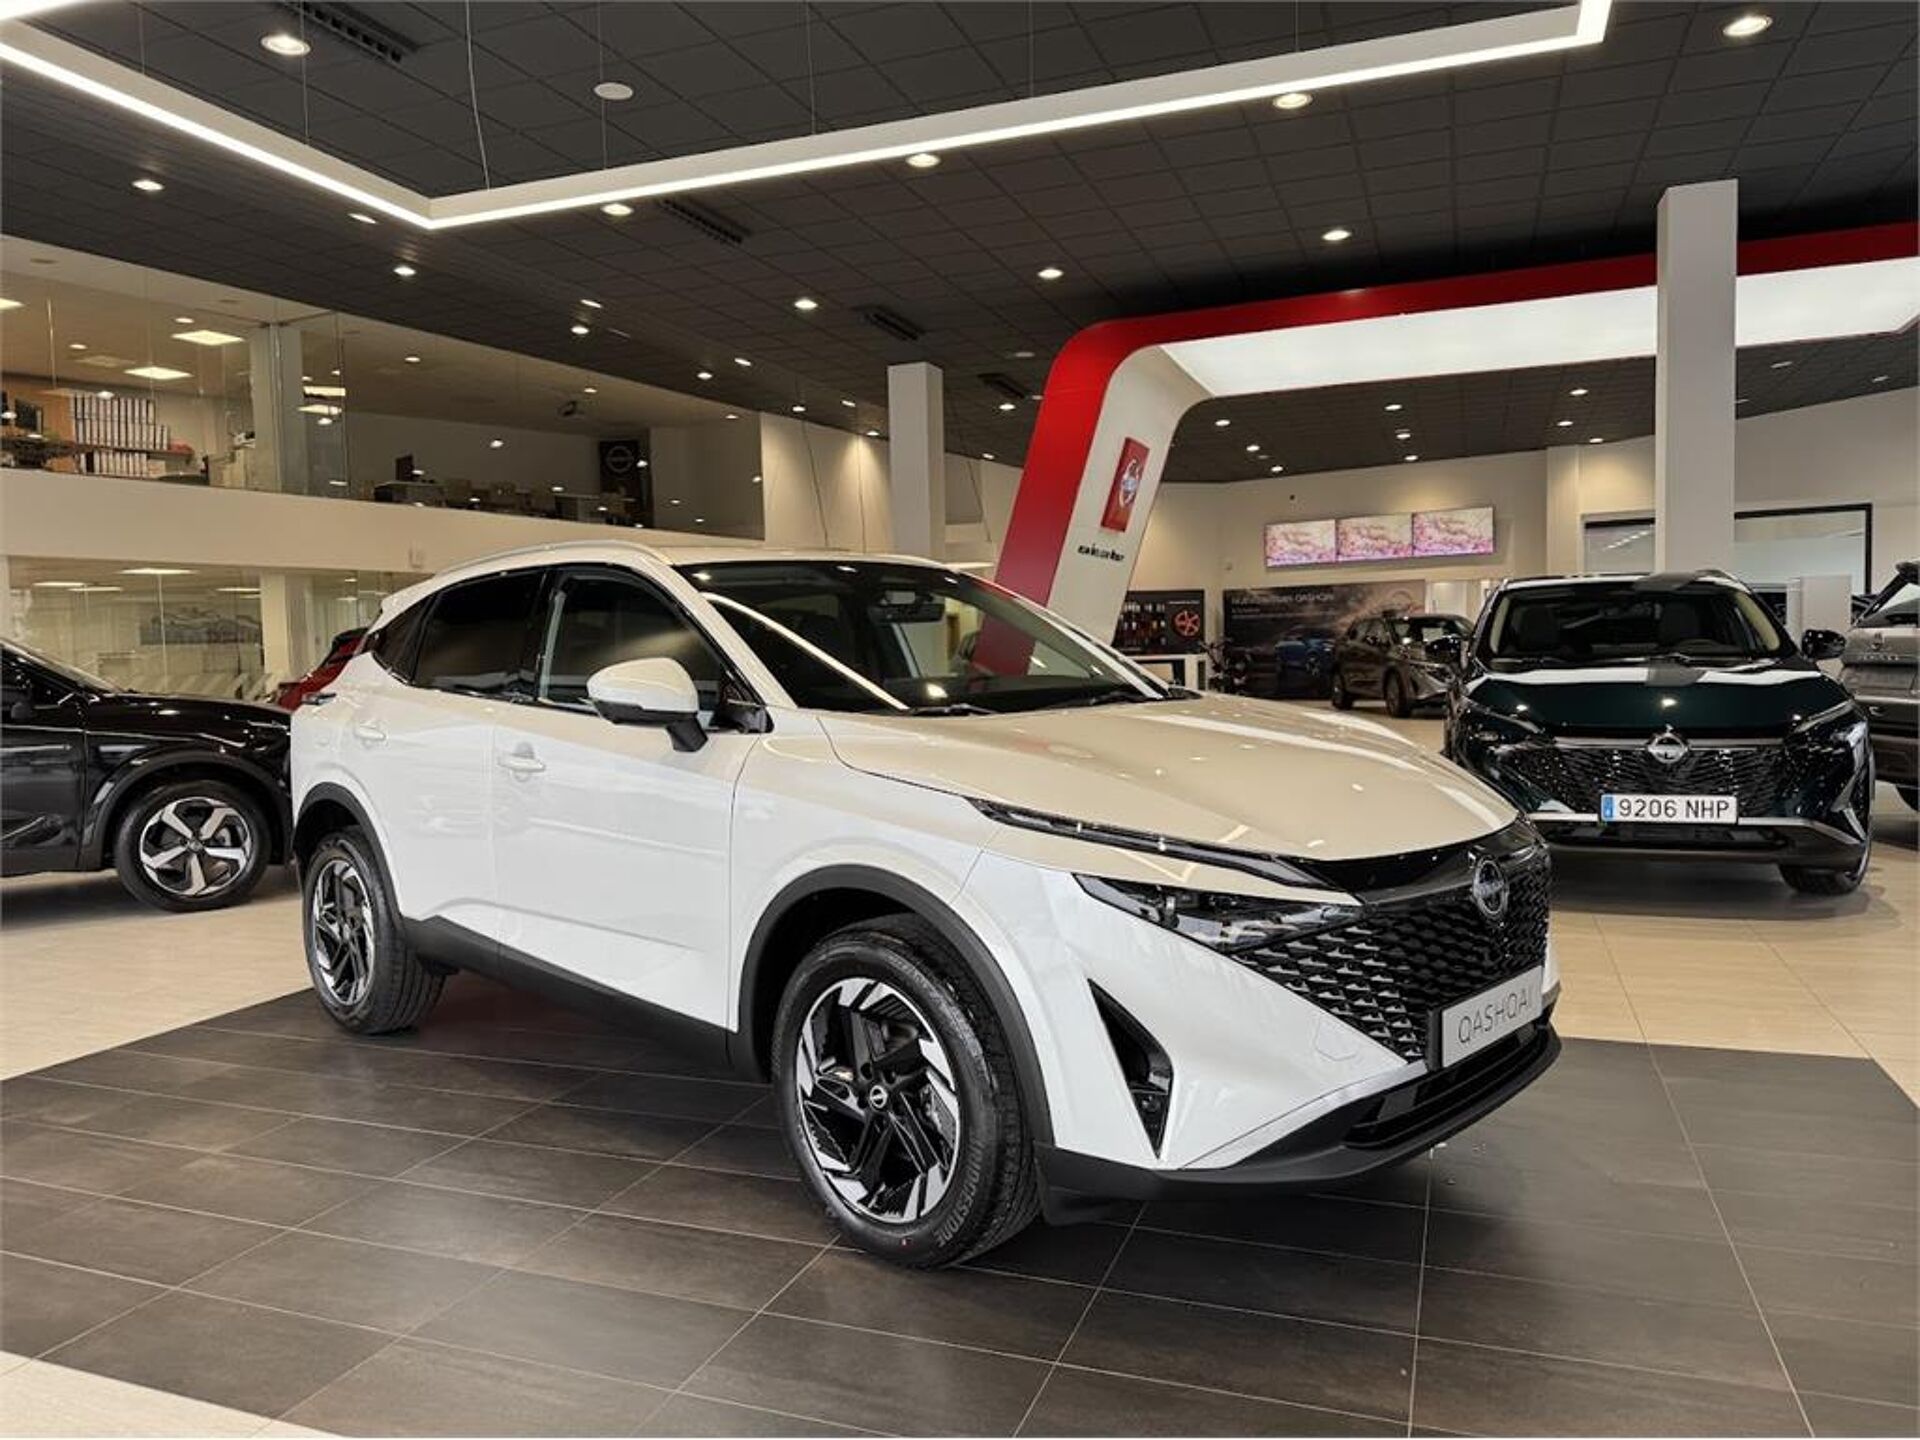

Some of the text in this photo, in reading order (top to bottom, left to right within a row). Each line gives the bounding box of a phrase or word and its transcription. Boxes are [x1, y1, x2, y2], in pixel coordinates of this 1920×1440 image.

[1619, 798, 1677, 818] 9206
[1685, 799, 1730, 819] NHP
[1458, 986, 1533, 1046] QASHQAI
